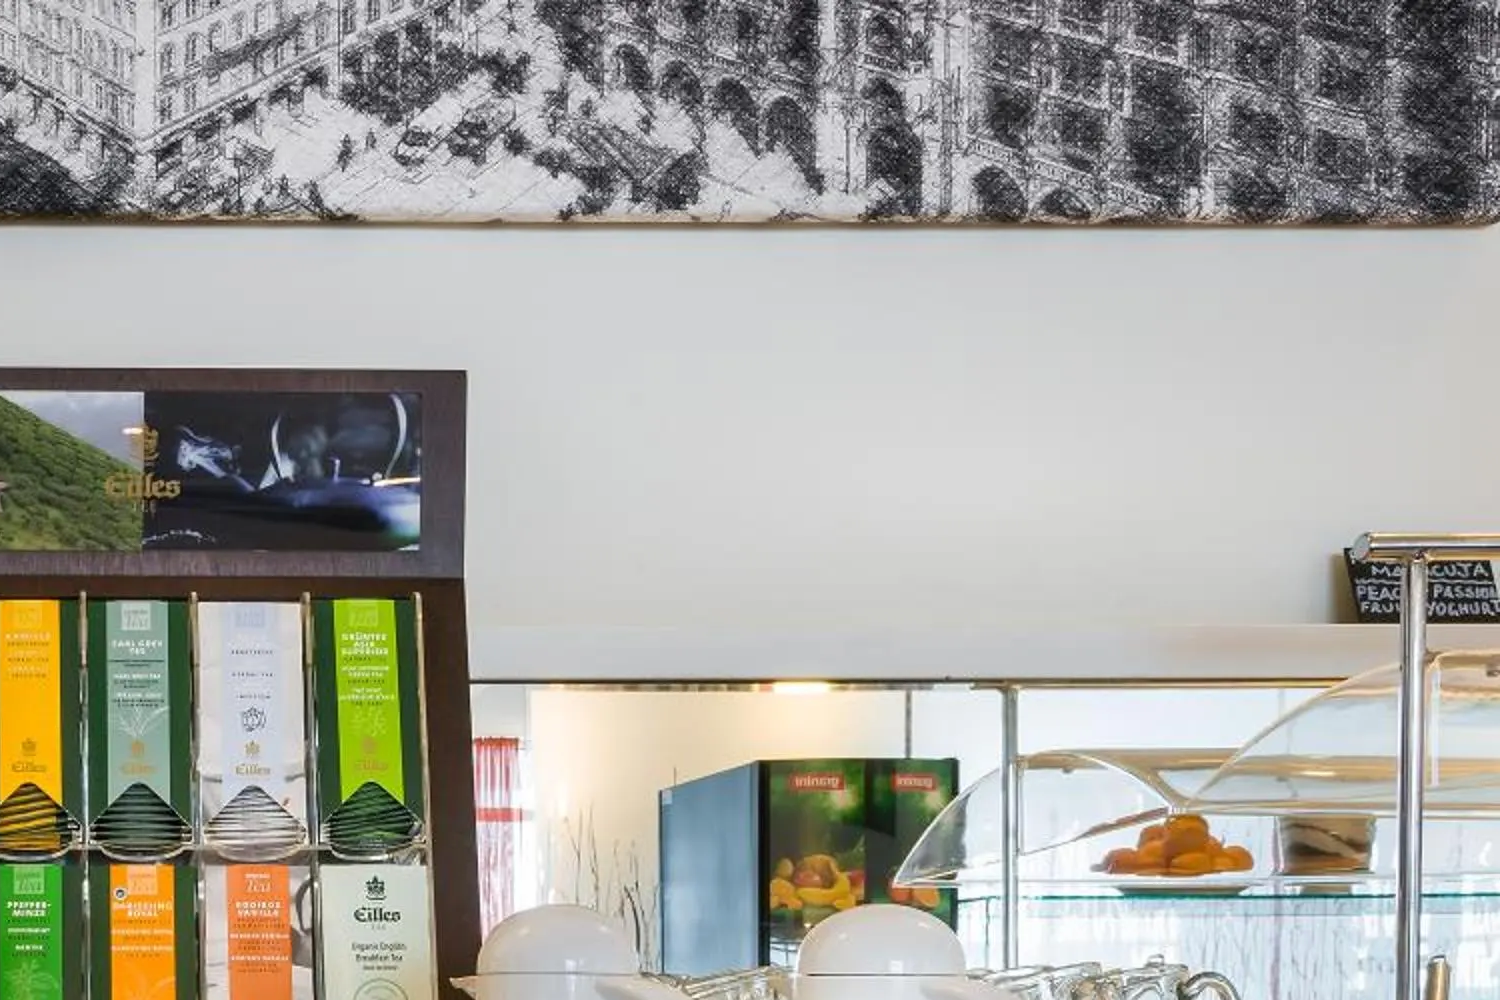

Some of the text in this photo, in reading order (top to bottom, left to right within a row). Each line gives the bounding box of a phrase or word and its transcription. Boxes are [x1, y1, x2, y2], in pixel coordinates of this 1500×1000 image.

[104, 472, 182, 499] Eilles
[1371, 563, 1490, 577] MACUJA
[1357, 585, 1401, 600] PEAC
[354, 906, 401, 922] Eilles
[391, 953, 403, 961] Tea
